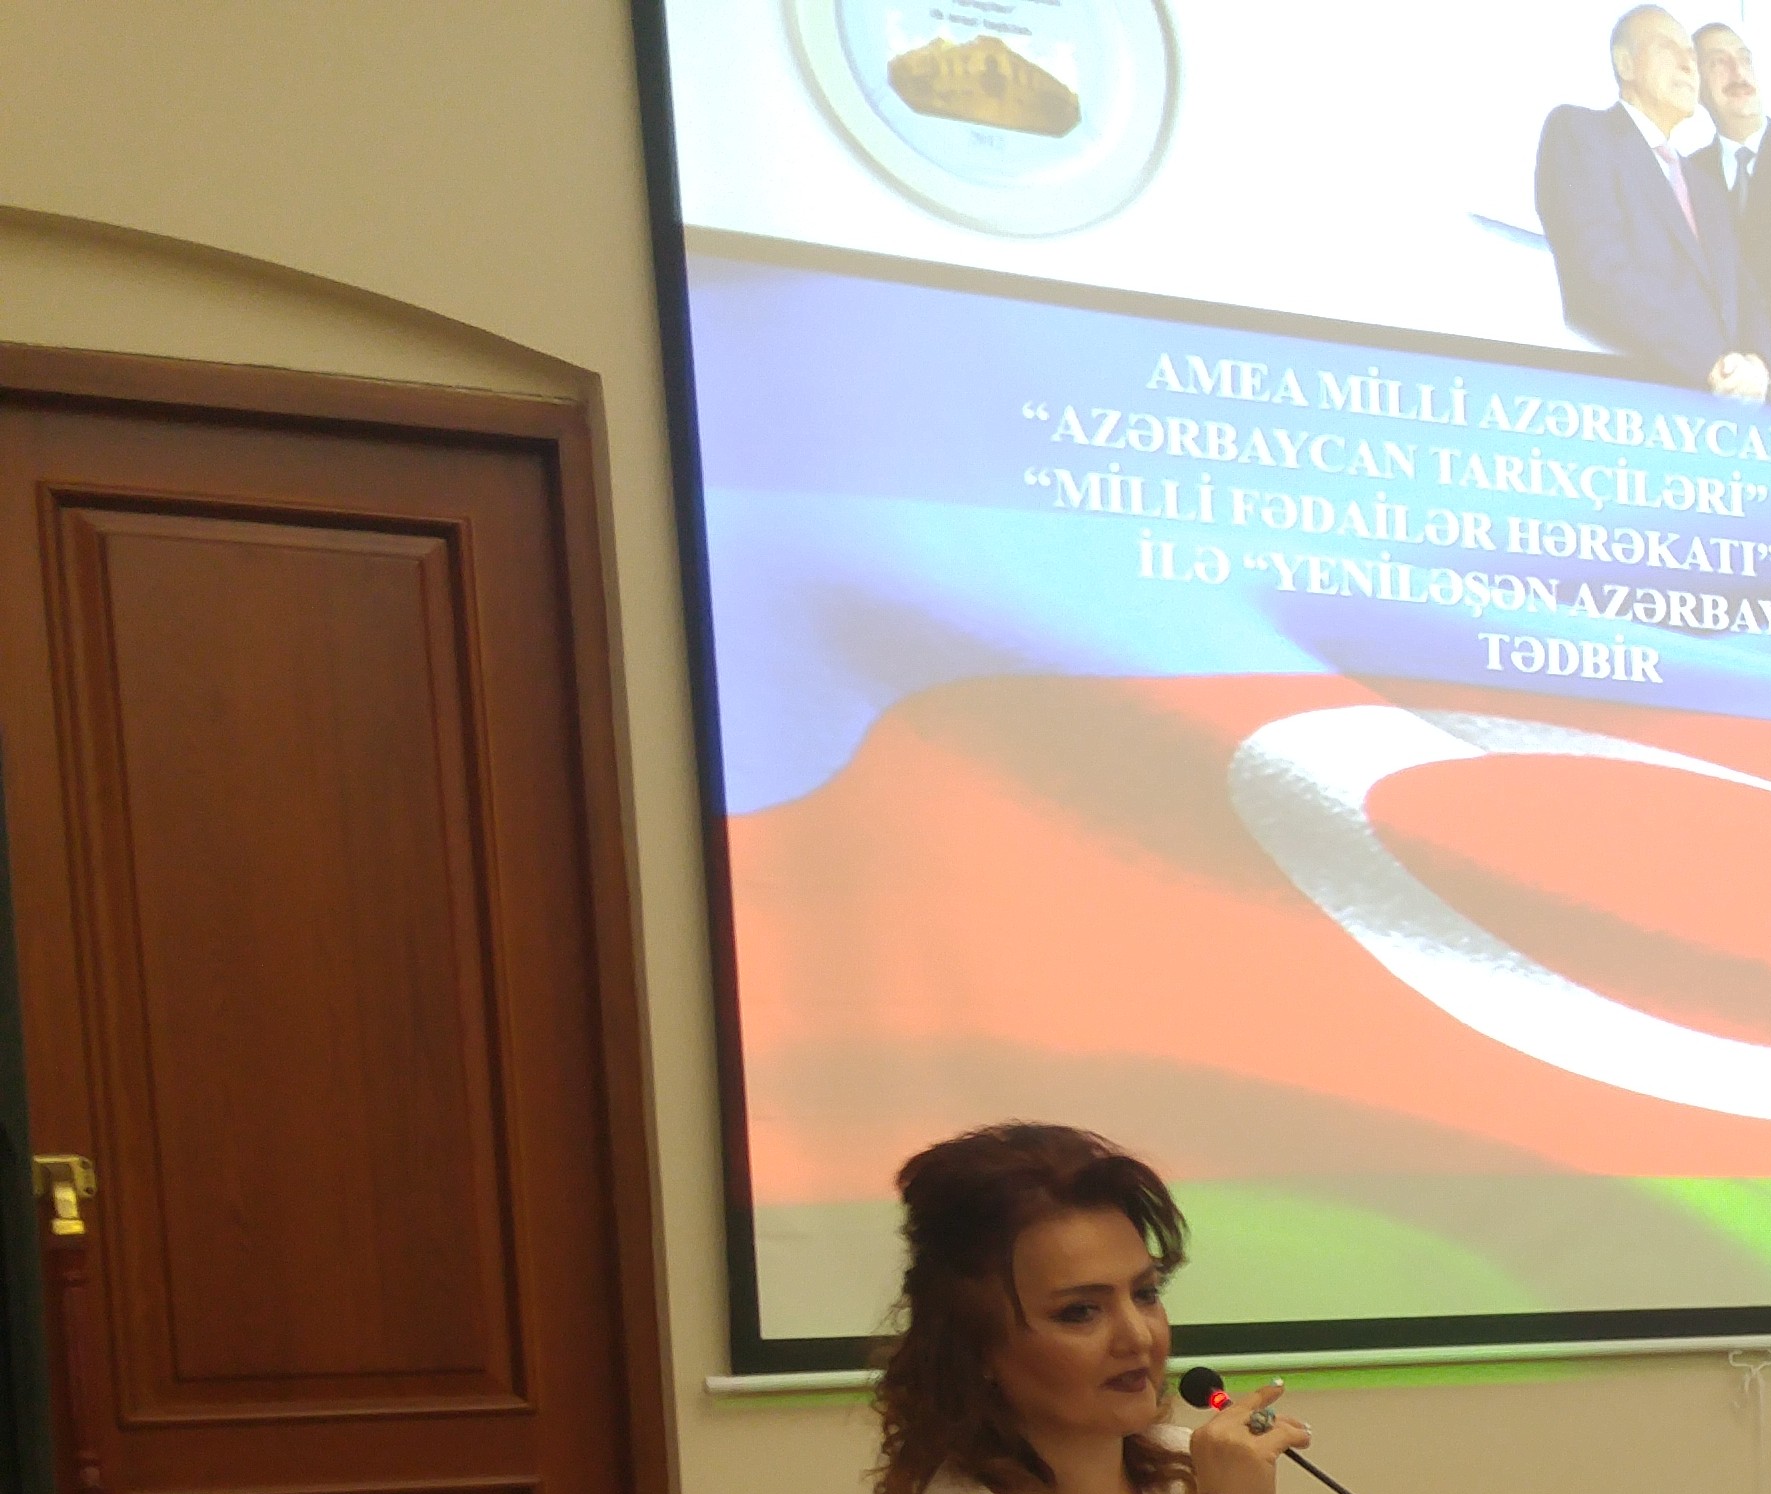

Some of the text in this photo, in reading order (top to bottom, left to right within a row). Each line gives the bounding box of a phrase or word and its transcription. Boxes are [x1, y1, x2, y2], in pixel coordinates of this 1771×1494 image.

[1147, 353, 1308, 406] AMEA
[1318, 367, 1467, 425] MİLLİ
[1023, 403, 1417, 479] “AZƏRBAYCAN
[1431, 447, 1767, 517] TARİXÇİLƏRİ”
[1025, 463, 1214, 522] “MİLLİ
[1231, 488, 1496, 550] FƏDAİLƏR
[1137, 528, 1230, 584] İLƏ
[1244, 551, 1564, 617] “YENİLƏŞƏN
[1478, 628, 1667, 683] TƏDBİR
